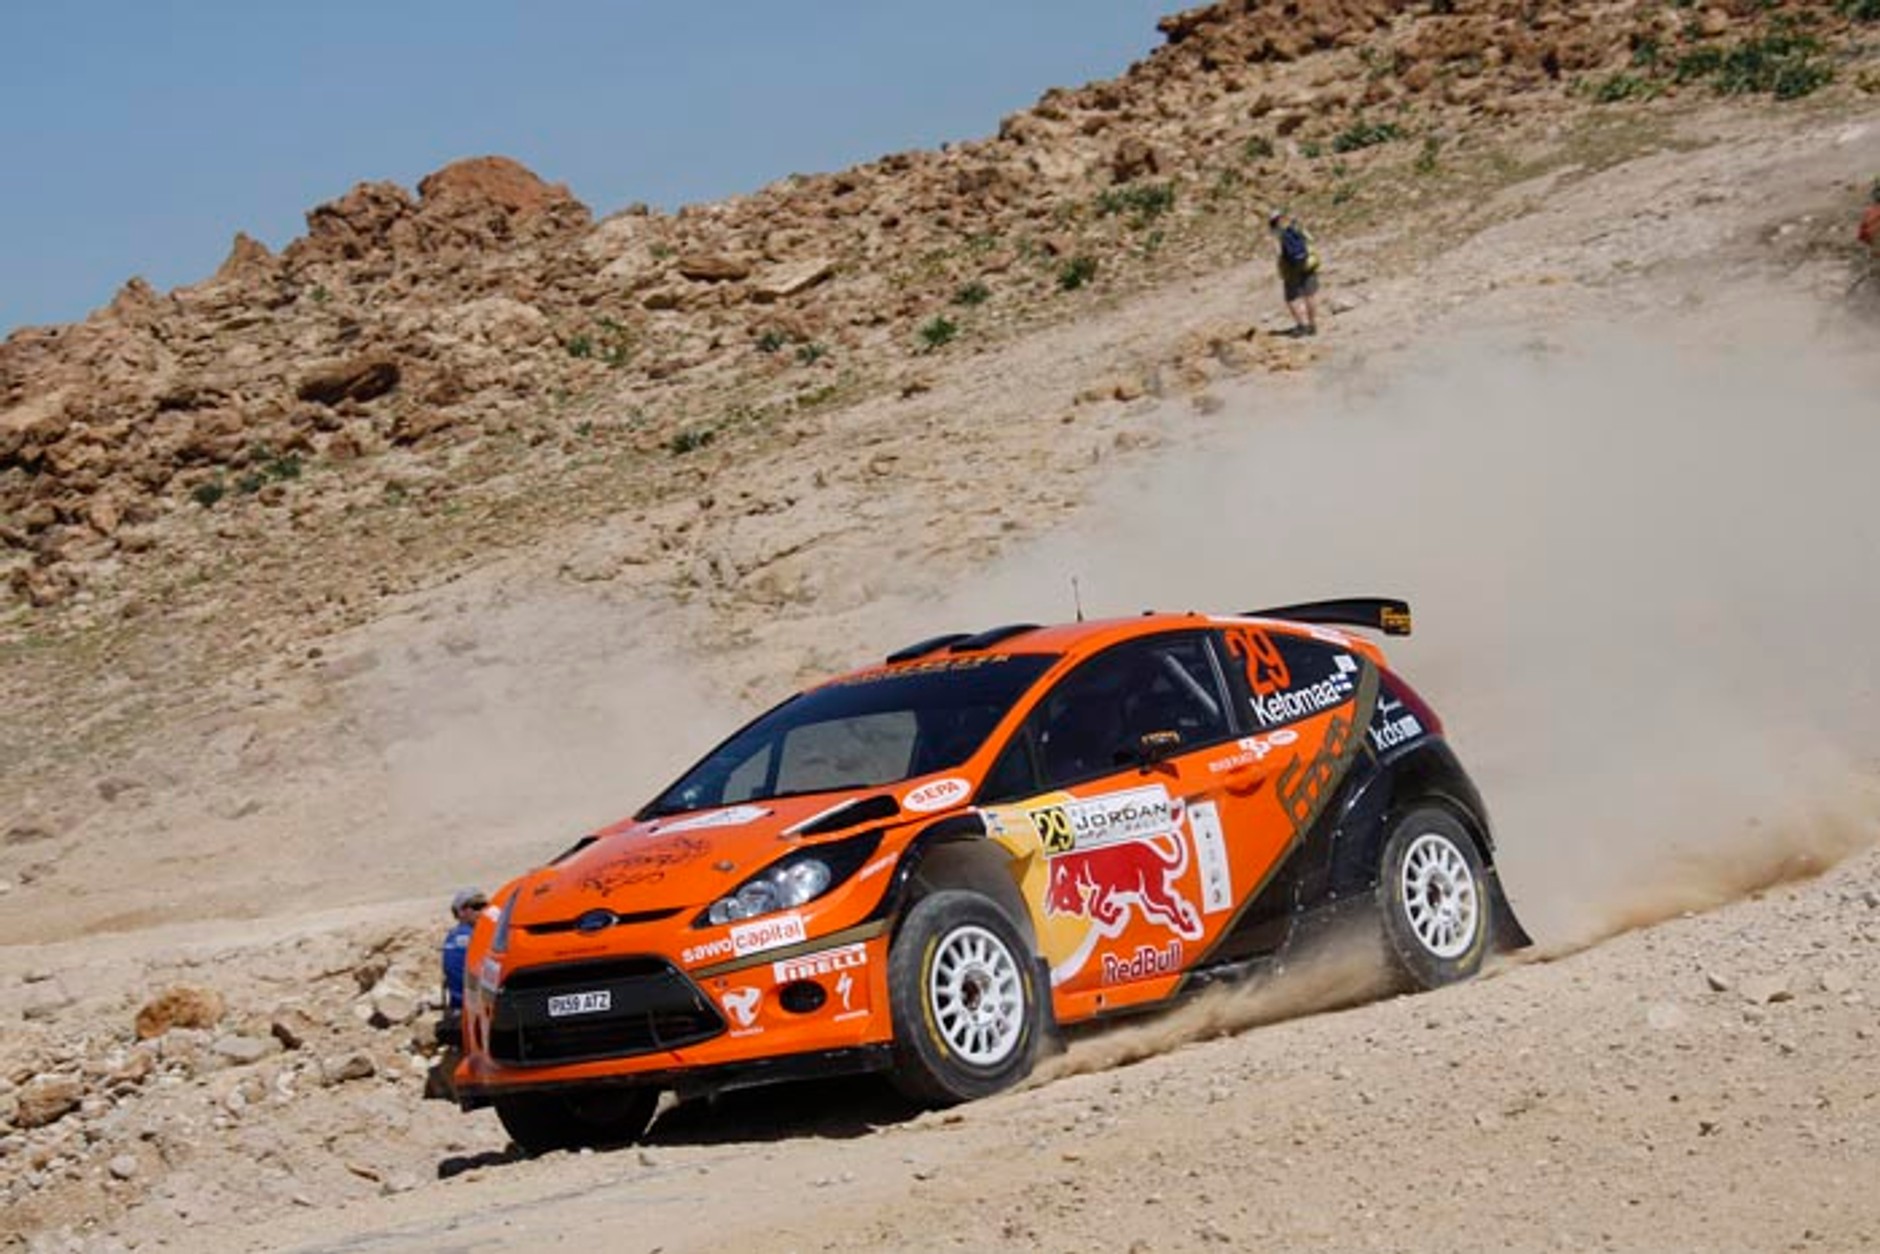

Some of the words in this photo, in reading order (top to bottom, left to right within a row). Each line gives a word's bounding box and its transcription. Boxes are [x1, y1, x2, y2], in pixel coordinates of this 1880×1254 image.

[1224, 627, 1290, 697] 29
[911, 781, 960, 804] SEPA
[1036, 808, 1076, 850] 29
[1077, 803, 1167, 831] JORDAN
[682, 938, 732, 963] sawo
[735, 921, 801, 950] capital
[774, 942, 867, 984] PIRELLI
